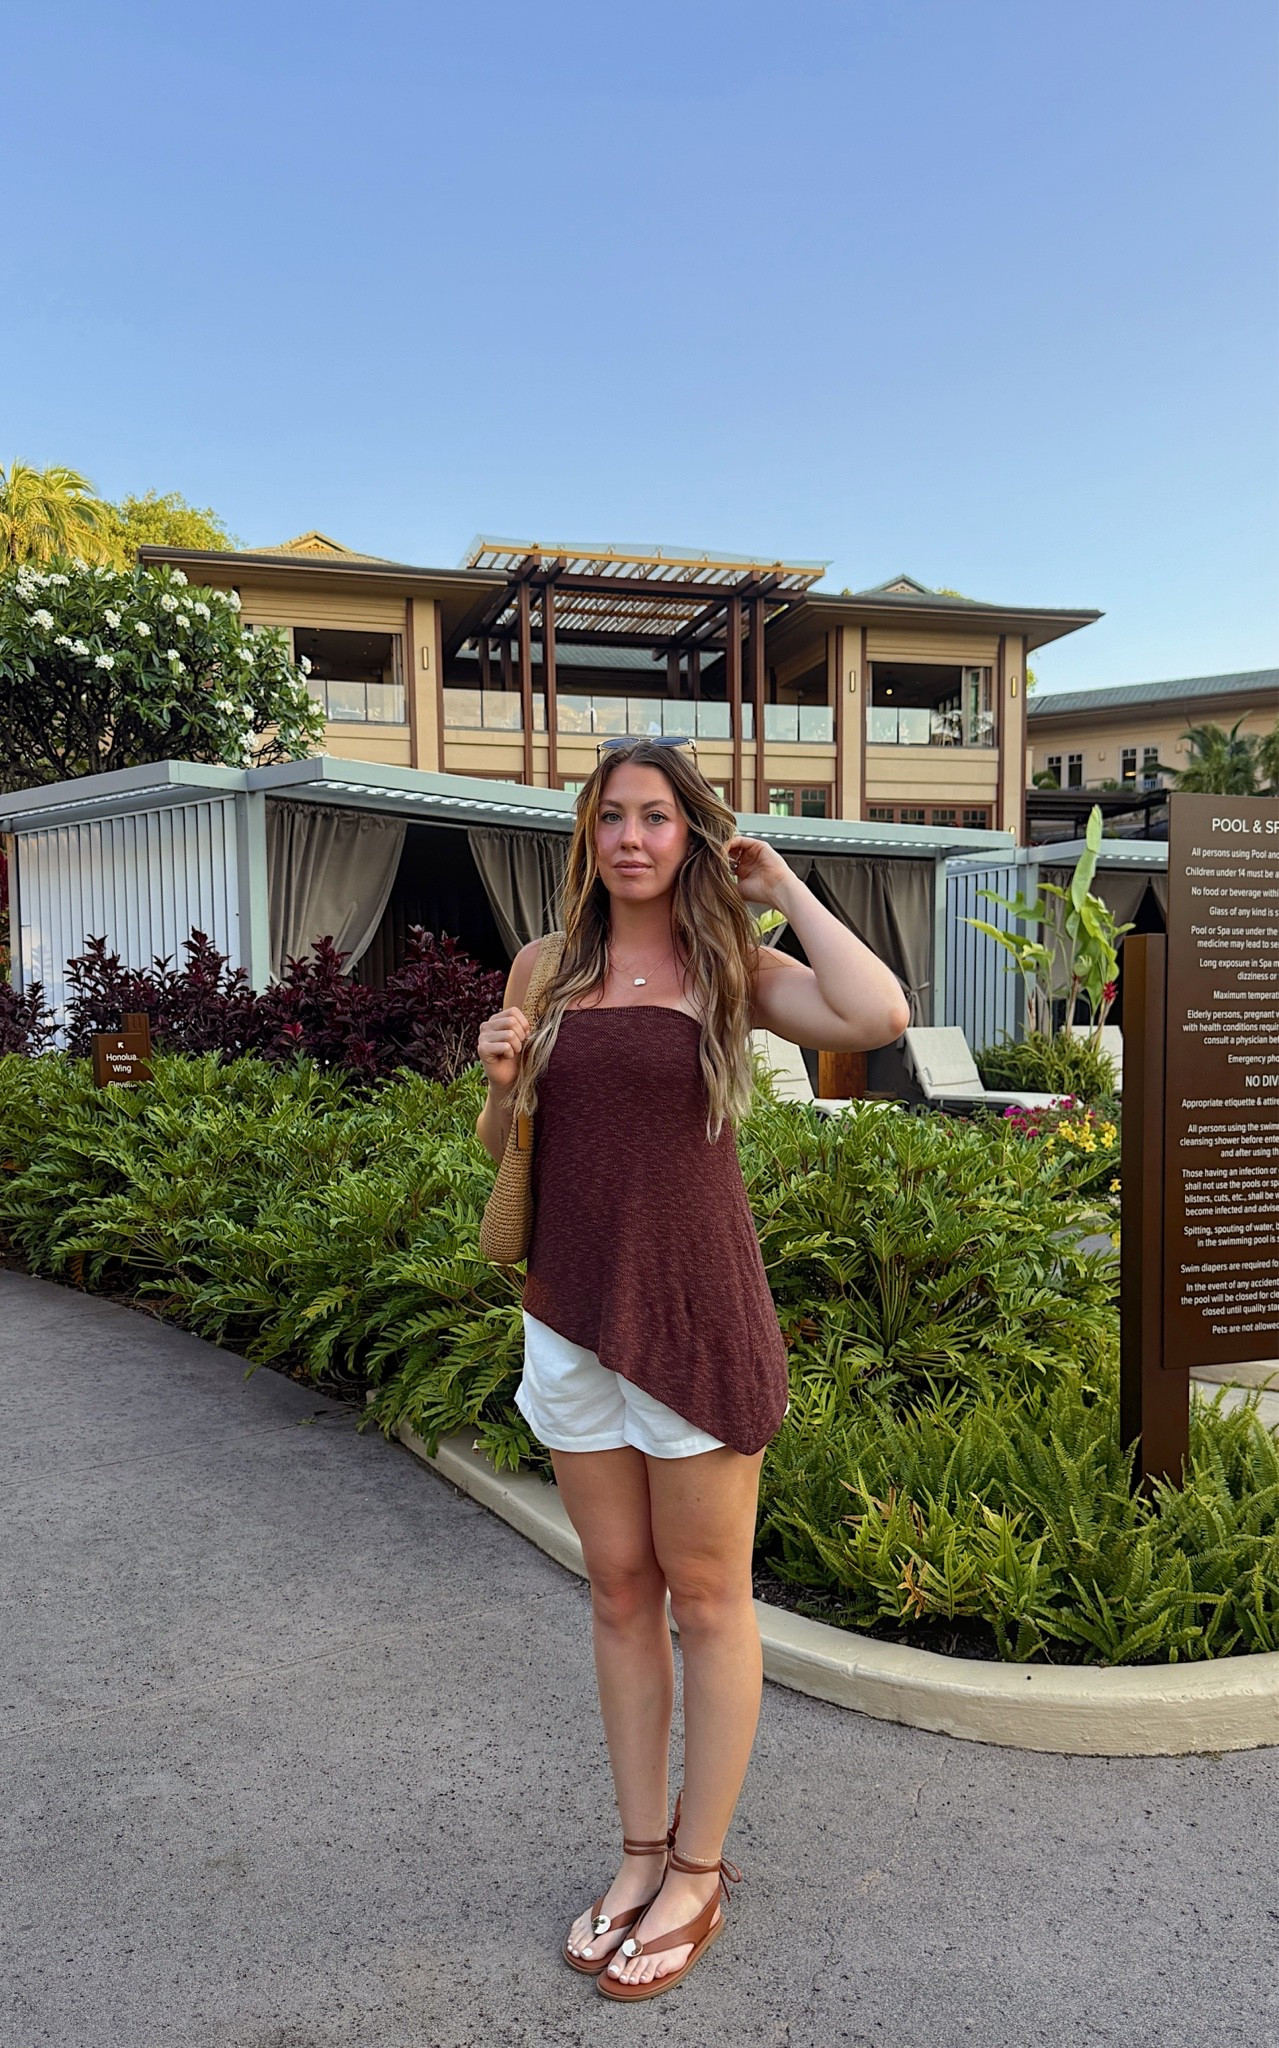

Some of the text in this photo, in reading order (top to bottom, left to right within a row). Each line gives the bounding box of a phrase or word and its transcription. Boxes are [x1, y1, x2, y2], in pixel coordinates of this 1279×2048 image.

[1212, 818, 1249, 832] POOL
[1253, 820, 1261, 833] &
[1192, 848, 1200, 856] All
[1202, 849, 1230, 858] persons
[1232, 850, 1250, 860] using
[1252, 850, 1266, 858] Pool
[1186, 867, 1214, 876] Children
[1216, 868, 1237, 877] under
[1238, 869, 1245, 877] 14
[1265, 870, 1273, 878] be
[1192, 887, 1201, 895] No
[1203, 887, 1219, 895] food
[1229, 888, 1261, 899] beverage
[1209, 907, 1228, 915] Glass
[1230, 907, 1237, 915] of
[1238, 909, 1250, 918] any
[1252, 908, 1266, 916] kind
[1191, 926, 1206, 934] Pool
[1217, 926, 1230, 936] Spa
[1246, 927, 1265, 935] under
[1230, 941, 1244, 950] may
[1246, 940, 1261, 948] lead
[1200, 958, 1216, 969] Long
[1218, 960, 1250, 969] exposure
[1251, 959, 1257, 967] in
[1259, 959, 1272, 969] Spa
[1238, 972, 1268, 980] dizziness
[1214, 991, 1246, 999] Maximum
[1187, 1010, 1211, 1020] Elderly
[1213, 1011, 1242, 1019] persons,
[1244, 1011, 1274, 1020] pregnant
[1183, 1023, 1198, 1031] with
[1200, 1023, 1221, 1031] health
[1223, 1023, 1258, 1031] conditions
[1204, 1036, 1229, 1044] consult
[1236, 1036, 1267, 1046] physician
[106, 1053, 137, 1061] Honolua
[1228, 1055, 1266, 1065] Emergency
[112, 1064, 132, 1073] Wing
[1246, 1075, 1260, 1087] NO
[1182, 1098, 1223, 1109] Appropriate
[1225, 1098, 1255, 1108] etiquette
[1188, 1124, 1197, 1132] All
[1199, 1125, 1226, 1134] persons
[1228, 1123, 1246, 1133] using
[1248, 1123, 1259, 1131] the
[1180, 1137, 1213, 1147] cleansing
[1215, 1136, 1239, 1145] shower
[1241, 1135, 1263, 1144] before
[1221, 1149, 1234, 1157] and
[1235, 1148, 1251, 1157] after
[1253, 1147, 1271, 1158] using
[1182, 1169, 1203, 1178] Those
[1205, 1168, 1228, 1178] having
[1239, 1167, 1268, 1175] infection
[1185, 1182, 1200, 1190] shall
[1203, 1182, 1214, 1190] not
[1242, 1179, 1260, 1189] pools
[1185, 1194, 1212, 1203] blisters,
[1214, 1194, 1230, 1202] cuts,
[1248, 1192, 1264, 1200] shall
[1186, 1208, 1213, 1216] become
[1215, 1205, 1242, 1214] infected
[1244, 1204, 1257, 1213] and
[1184, 1226, 1213, 1237] Spitting,
[1214, 1224, 1244, 1235] spouting
[1246, 1223, 1253, 1231] of
[1254, 1223, 1274, 1231] water,
[1197, 1239, 1203, 1247] in
[1205, 1238, 1217, 1246] the
[1218, 1236, 1252, 1246] swimming
[1254, 1235, 1268, 1245] pool
[1181, 1264, 1199, 1273] Swim
[1201, 1263, 1227, 1273] diapers
[1242, 1260, 1270, 1270] required
[1186, 1283, 1193, 1291] In
[1195, 1283, 1206, 1291] the
[1208, 1282, 1227, 1290] event
[1229, 1280, 1236, 1289] of
[1237, 1281, 1249, 1290] any
[1181, 1297, 1192, 1305] the
[1194, 1295, 1210, 1306] pool
[1211, 1294, 1224, 1302] will
[1225, 1293, 1234, 1302] be
[1235, 1292, 1257, 1301] closed
[1259, 1291, 1268, 1299] for
[1202, 1307, 1225, 1316] closed
[1227, 1305, 1242, 1314] until
[1243, 1304, 1266, 1314] quality
[1213, 1325, 1227, 1334] Pets
